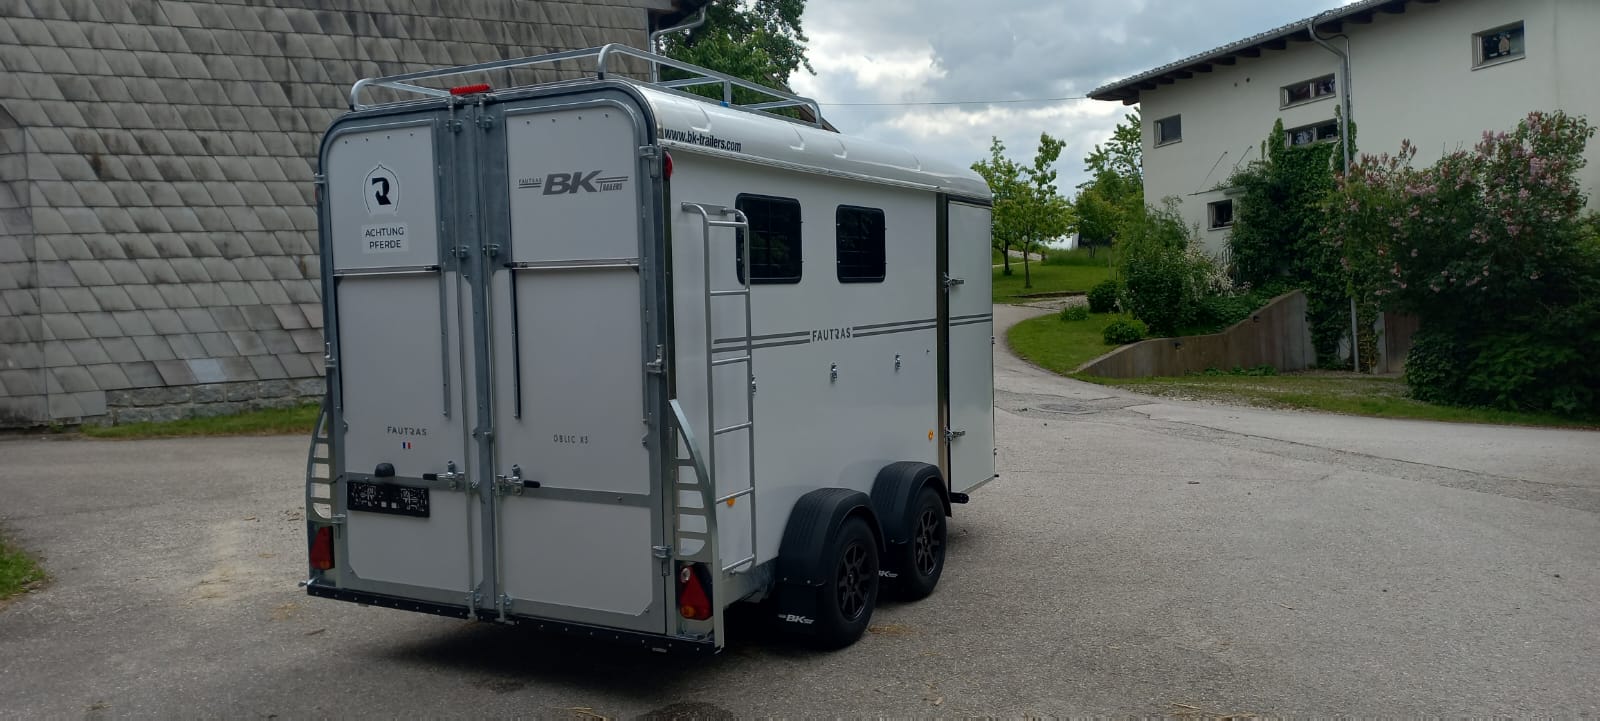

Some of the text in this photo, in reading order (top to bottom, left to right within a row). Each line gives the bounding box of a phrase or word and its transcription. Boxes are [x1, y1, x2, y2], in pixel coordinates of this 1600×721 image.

[664, 128, 742, 152] www.bk-trailers.com
[542, 170, 603, 196] BK
[365, 226, 405, 237] ACHTUNG
[369, 239, 402, 250] PFERDE
[387, 426, 427, 436] FAUTRAS
